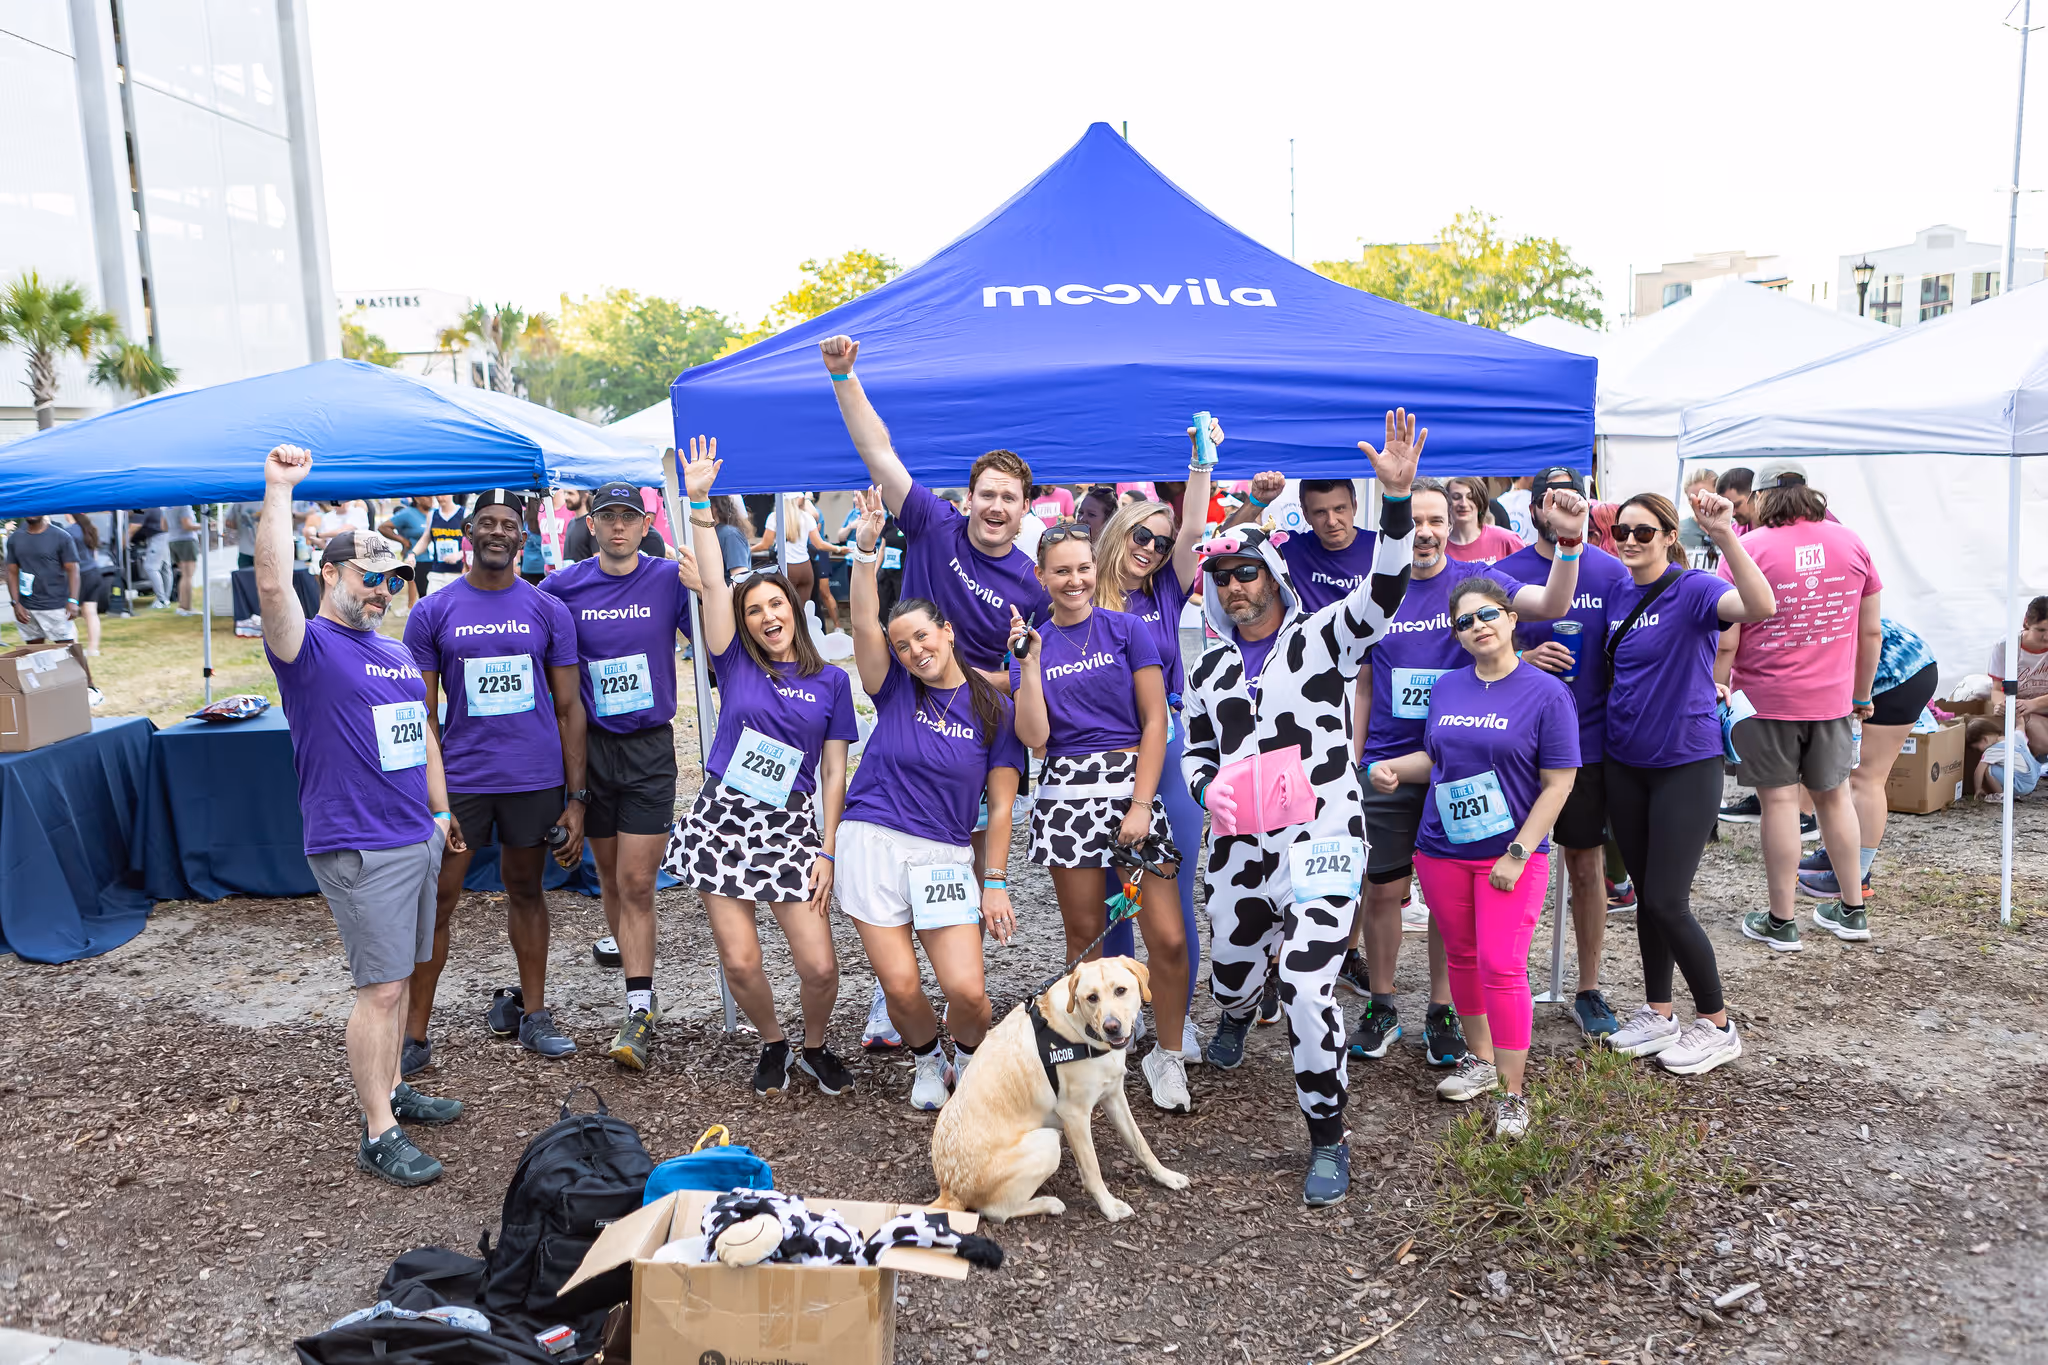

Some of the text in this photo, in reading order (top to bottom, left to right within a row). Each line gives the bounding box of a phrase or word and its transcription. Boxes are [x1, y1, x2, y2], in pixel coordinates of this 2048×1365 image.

[356, 296, 420, 308] MASTERS
[983, 278, 1278, 307] moovila
[949, 557, 1004, 610] moovila
[1311, 571, 1363, 589] moovil
[1571, 593, 1602, 609] vila
[582, 603, 651, 621] moovila
[1610, 611, 1660, 631] mvila
[455, 620, 531, 638] moovila
[365, 663, 422, 681] moovila
[1046, 651, 1114, 681] moovila
[478, 675, 522, 694] 2235
[600, 674, 639, 695] 2232
[774, 683, 816, 703] ovila
[1402, 688, 1431, 706] 223
[1438, 713, 1508, 730] moovila
[391, 722, 423, 744] 2234
[742, 750, 786, 782] 2239
[1449, 795, 1490, 821] 2237
[1305, 855, 1351, 876] 2242
[924, 883, 966, 904] 2245
[1049, 1048, 1075, 1064] JACOB
